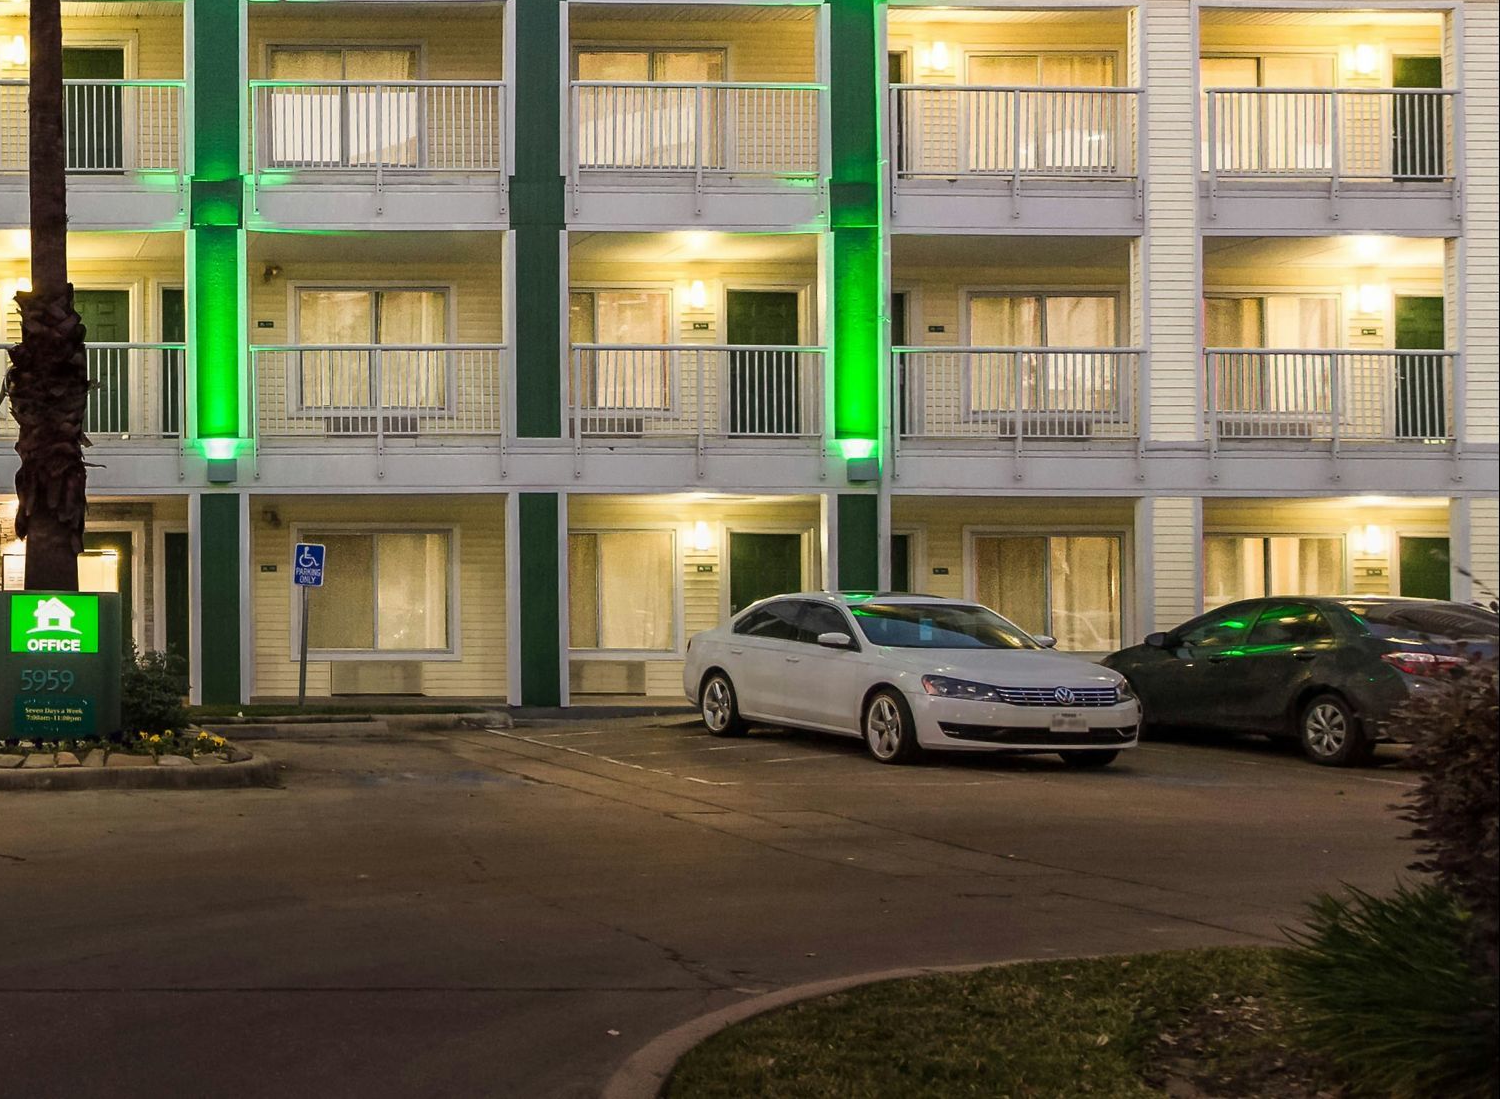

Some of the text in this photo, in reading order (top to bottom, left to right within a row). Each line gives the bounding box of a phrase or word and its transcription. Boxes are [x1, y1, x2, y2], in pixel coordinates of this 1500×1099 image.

[296, 567, 321, 576] PARKING
[299, 575, 316, 584] ONLY
[27, 639, 81, 651] OFFICE
[20, 669, 75, 692] 5959
[44, 707, 60, 715] Days
